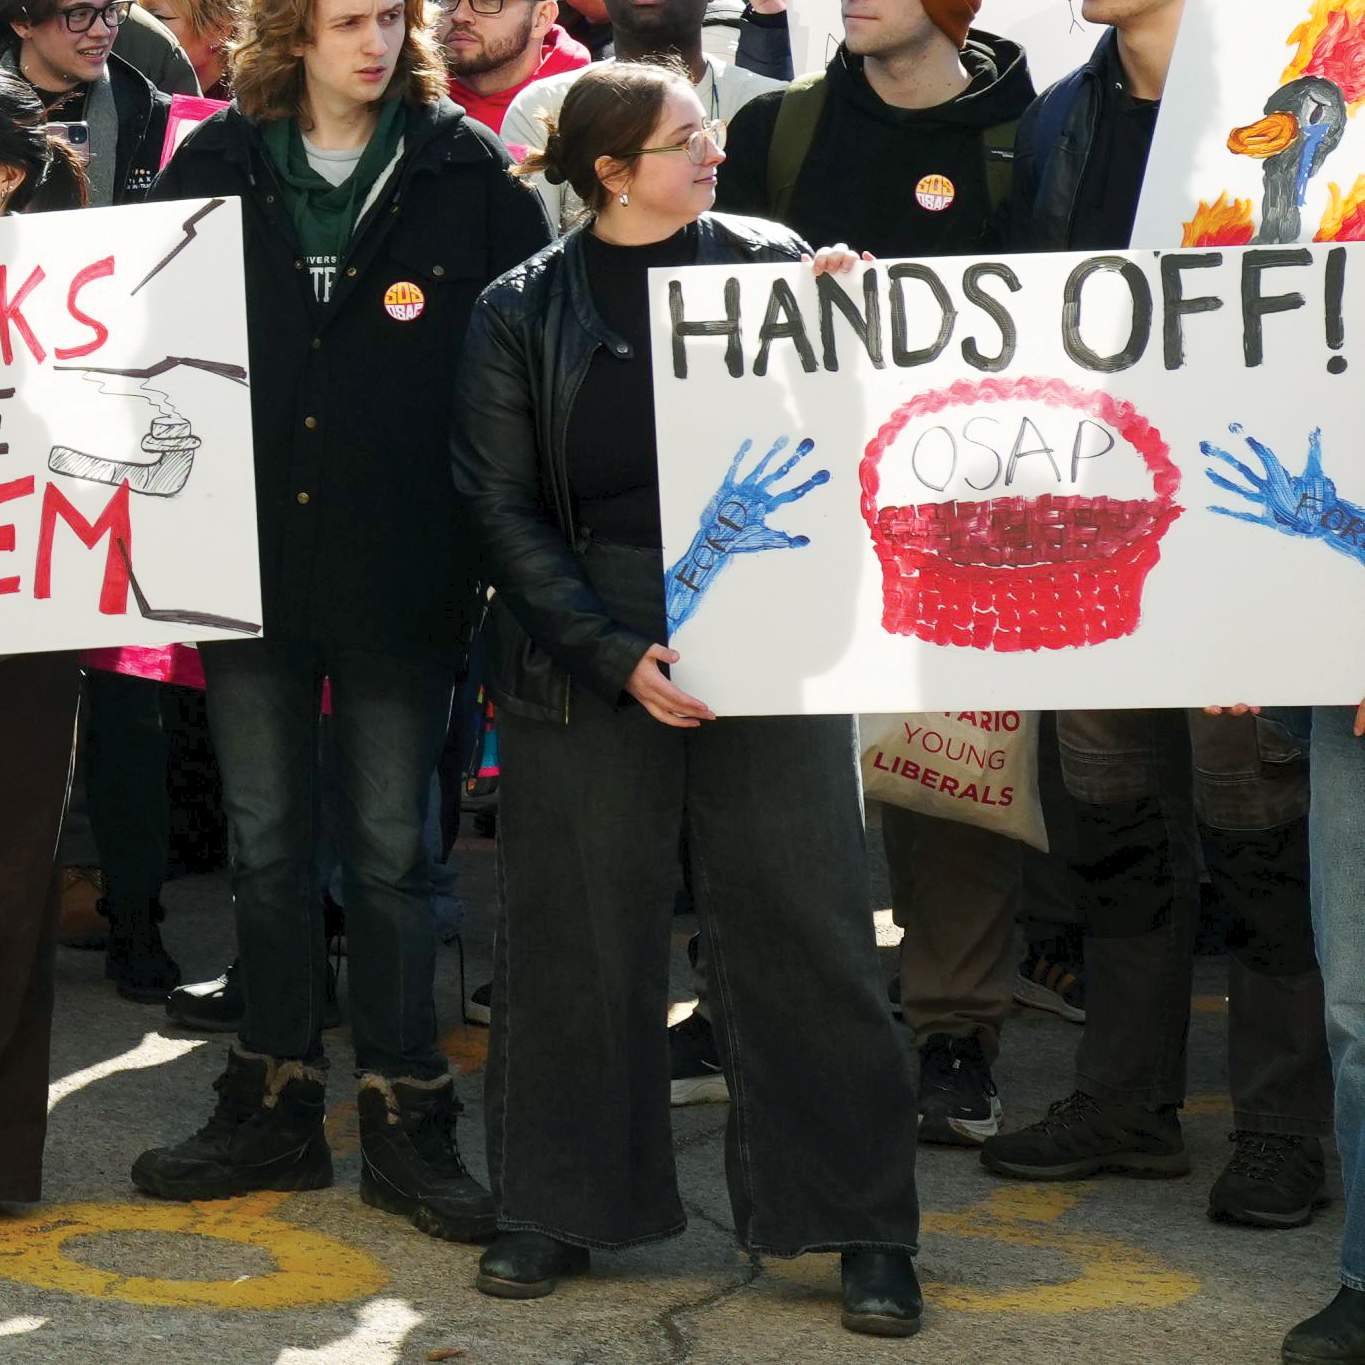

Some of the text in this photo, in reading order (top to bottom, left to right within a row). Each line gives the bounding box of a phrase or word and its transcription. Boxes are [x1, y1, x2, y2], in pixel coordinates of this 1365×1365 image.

[916, 175, 955, 197] SOS
[384, 281, 425, 305] SOS
[668, 246, 1349, 379] HANDS OFF!
[911, 415, 1115, 492] OSAP
[1294, 492, 1365, 552] FOR
[904, 721, 1006, 770] YOUNG
[944, 711, 1020, 732] ARIO
[873, 751, 1014, 807] LIBERALS
